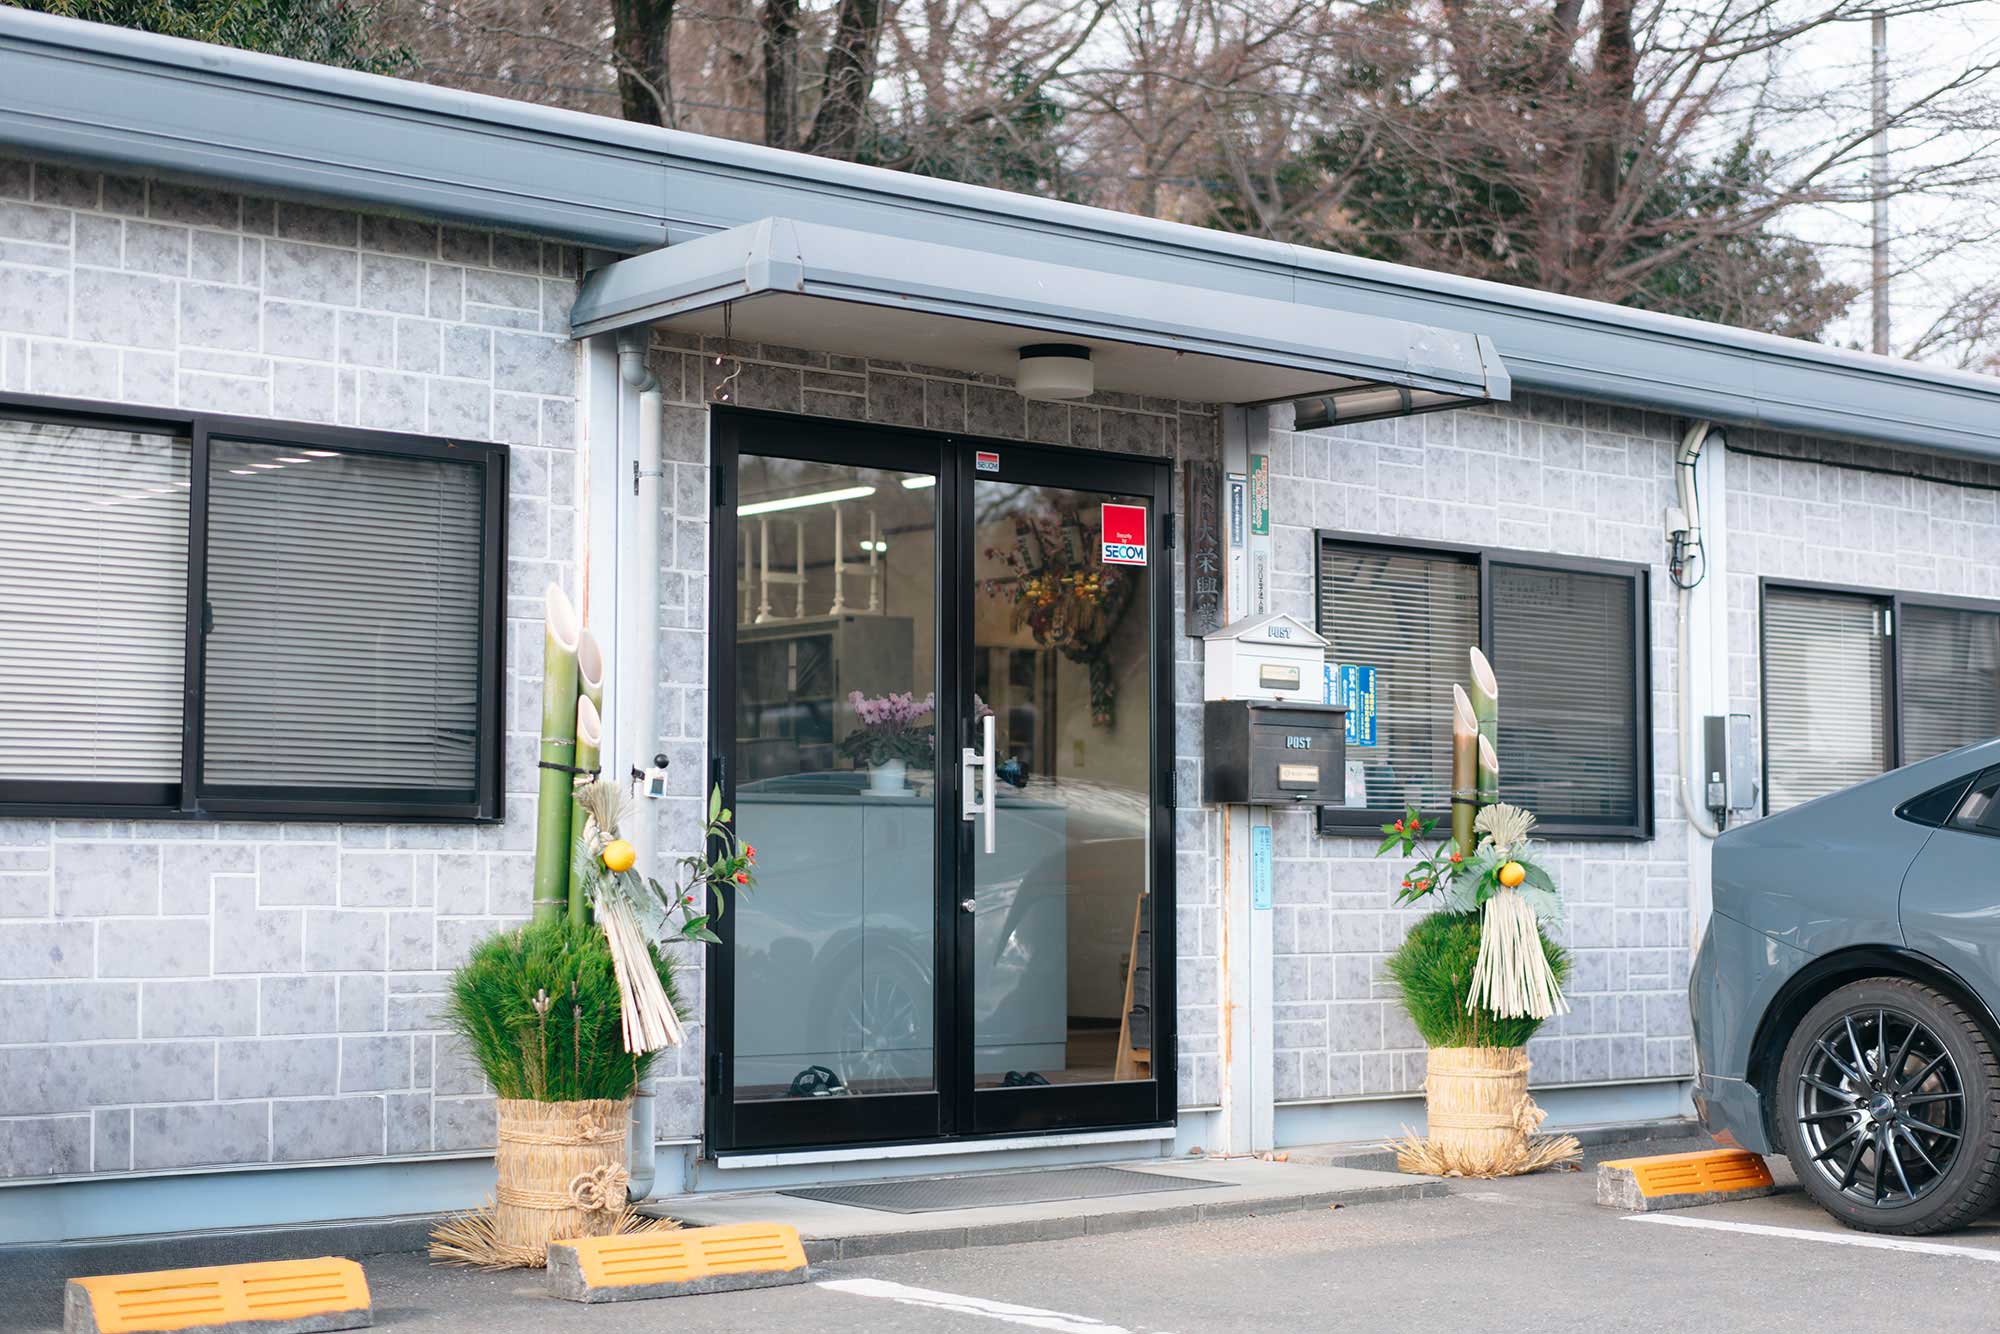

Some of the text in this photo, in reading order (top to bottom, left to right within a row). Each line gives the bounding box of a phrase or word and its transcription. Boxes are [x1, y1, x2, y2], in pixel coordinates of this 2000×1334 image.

[978, 461, 998, 470] SECOM
[1105, 545, 1144, 560] SECOM
[1268, 625, 1292, 639] POST
[1286, 736, 1312, 749] POST
